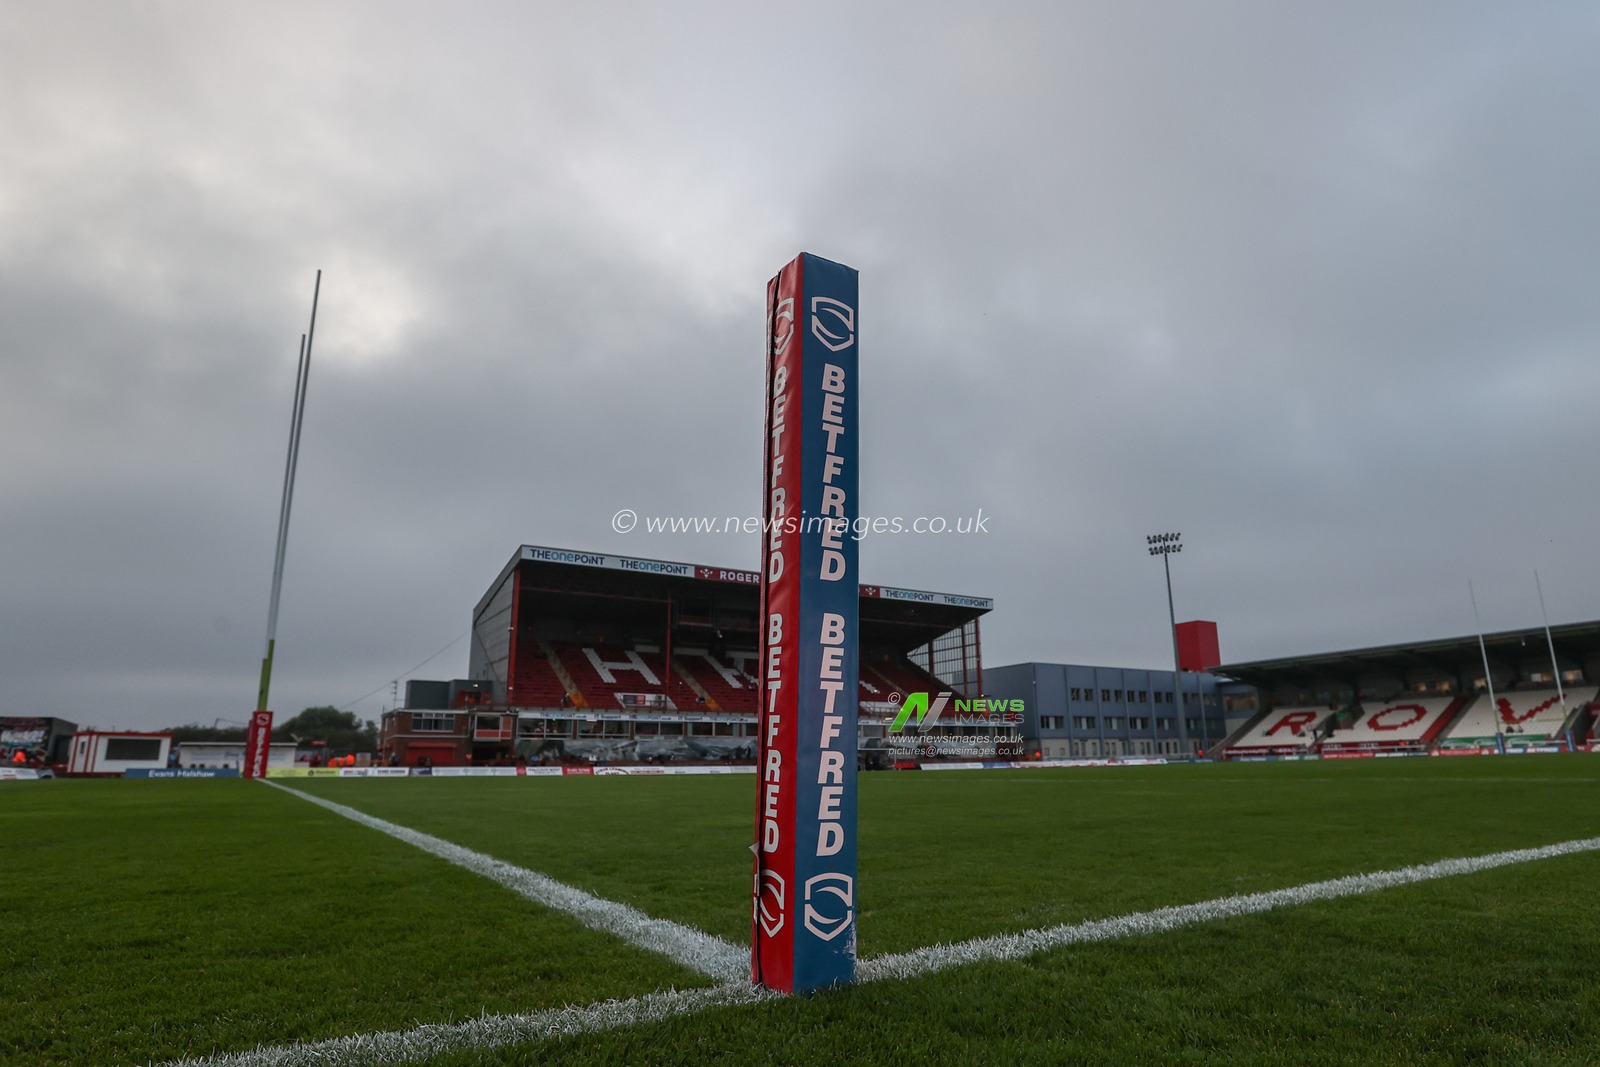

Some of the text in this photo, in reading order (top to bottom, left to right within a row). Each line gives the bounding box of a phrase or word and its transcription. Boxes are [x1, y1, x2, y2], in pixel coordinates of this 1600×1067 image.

[769, 365, 787, 584] BETFRED
[820, 363, 846, 582] BETFRED
[148, 769, 175, 777] Evans
[764, 613, 783, 853] BETFRED
[816, 612, 845, 857] BETFRED
